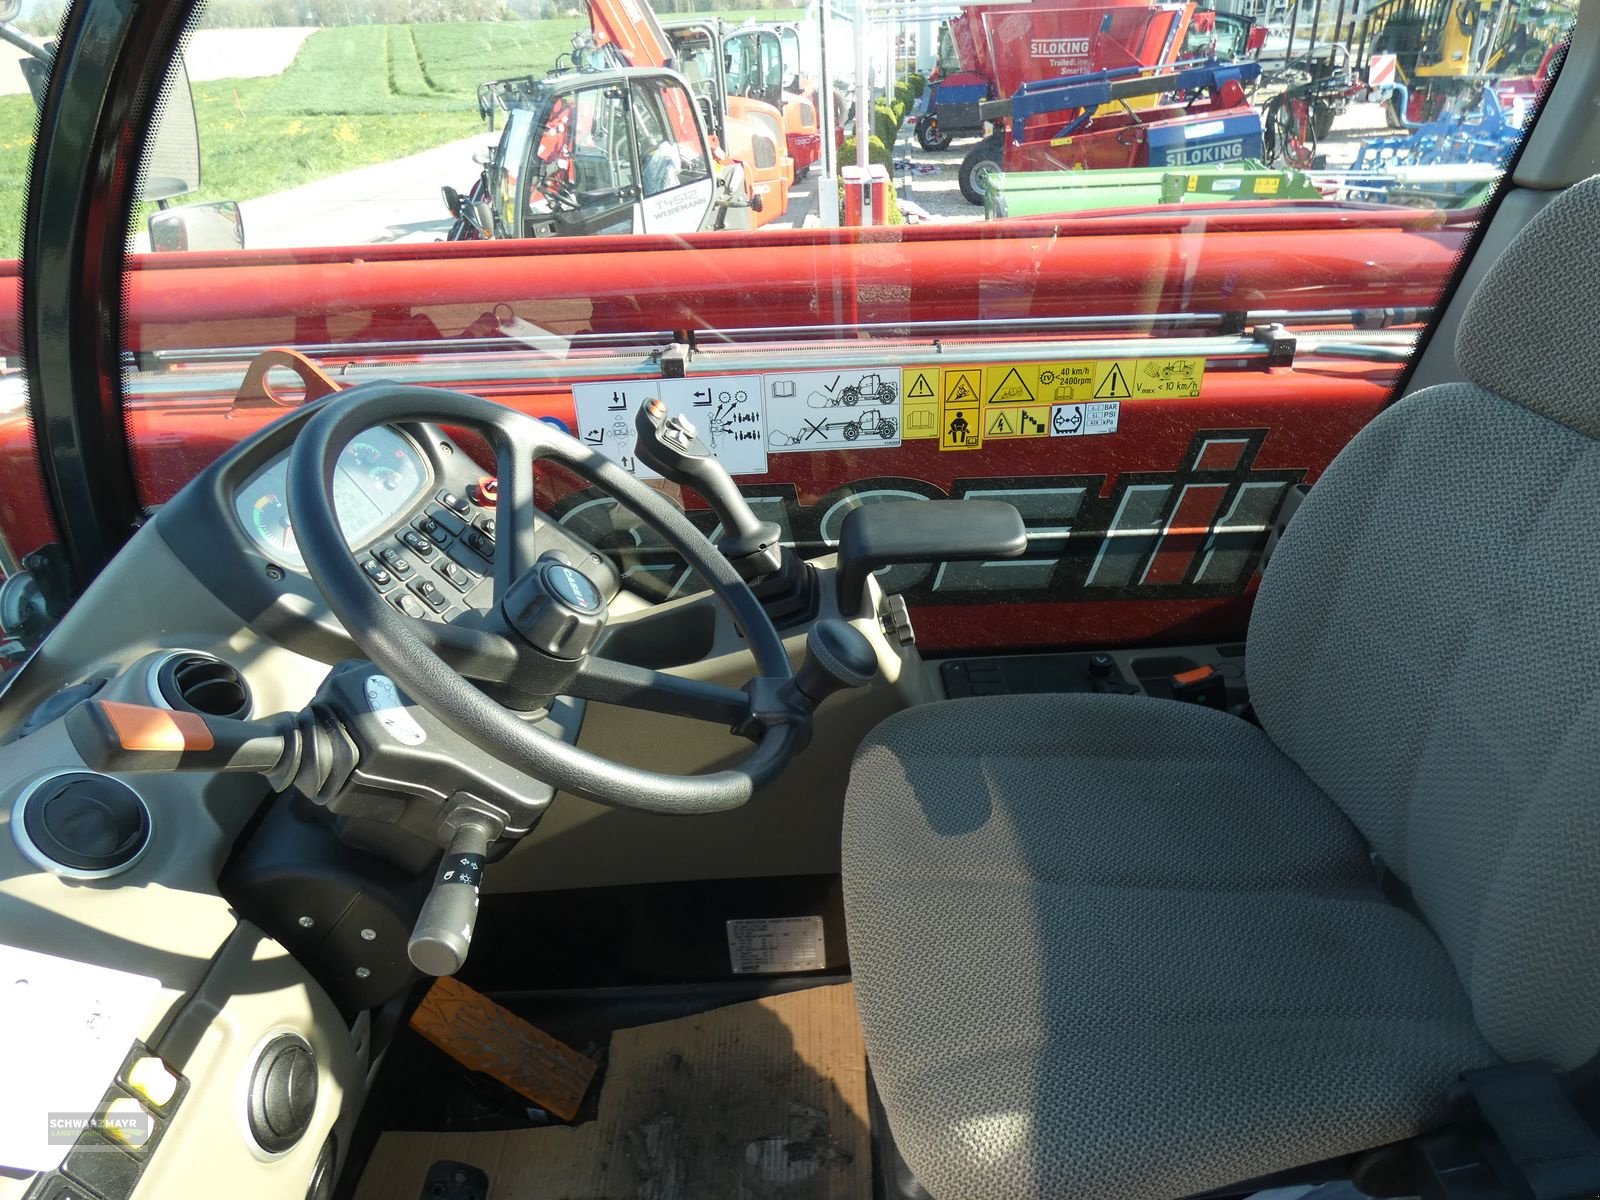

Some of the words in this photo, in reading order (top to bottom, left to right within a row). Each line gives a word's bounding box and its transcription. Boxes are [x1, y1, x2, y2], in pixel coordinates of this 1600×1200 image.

[1031, 42, 1089, 54] SILOKING
[1166, 144, 1242, 166] SILOKING
[1060, 367, 1070, 376] 40
[1072, 366, 1090, 375] km/h
[1060, 377, 1092, 386] 2400rpm
[1165, 381, 1174, 391] 10
[1176, 380, 1198, 391] km/h
[1104, 403, 1118, 411] BAR
